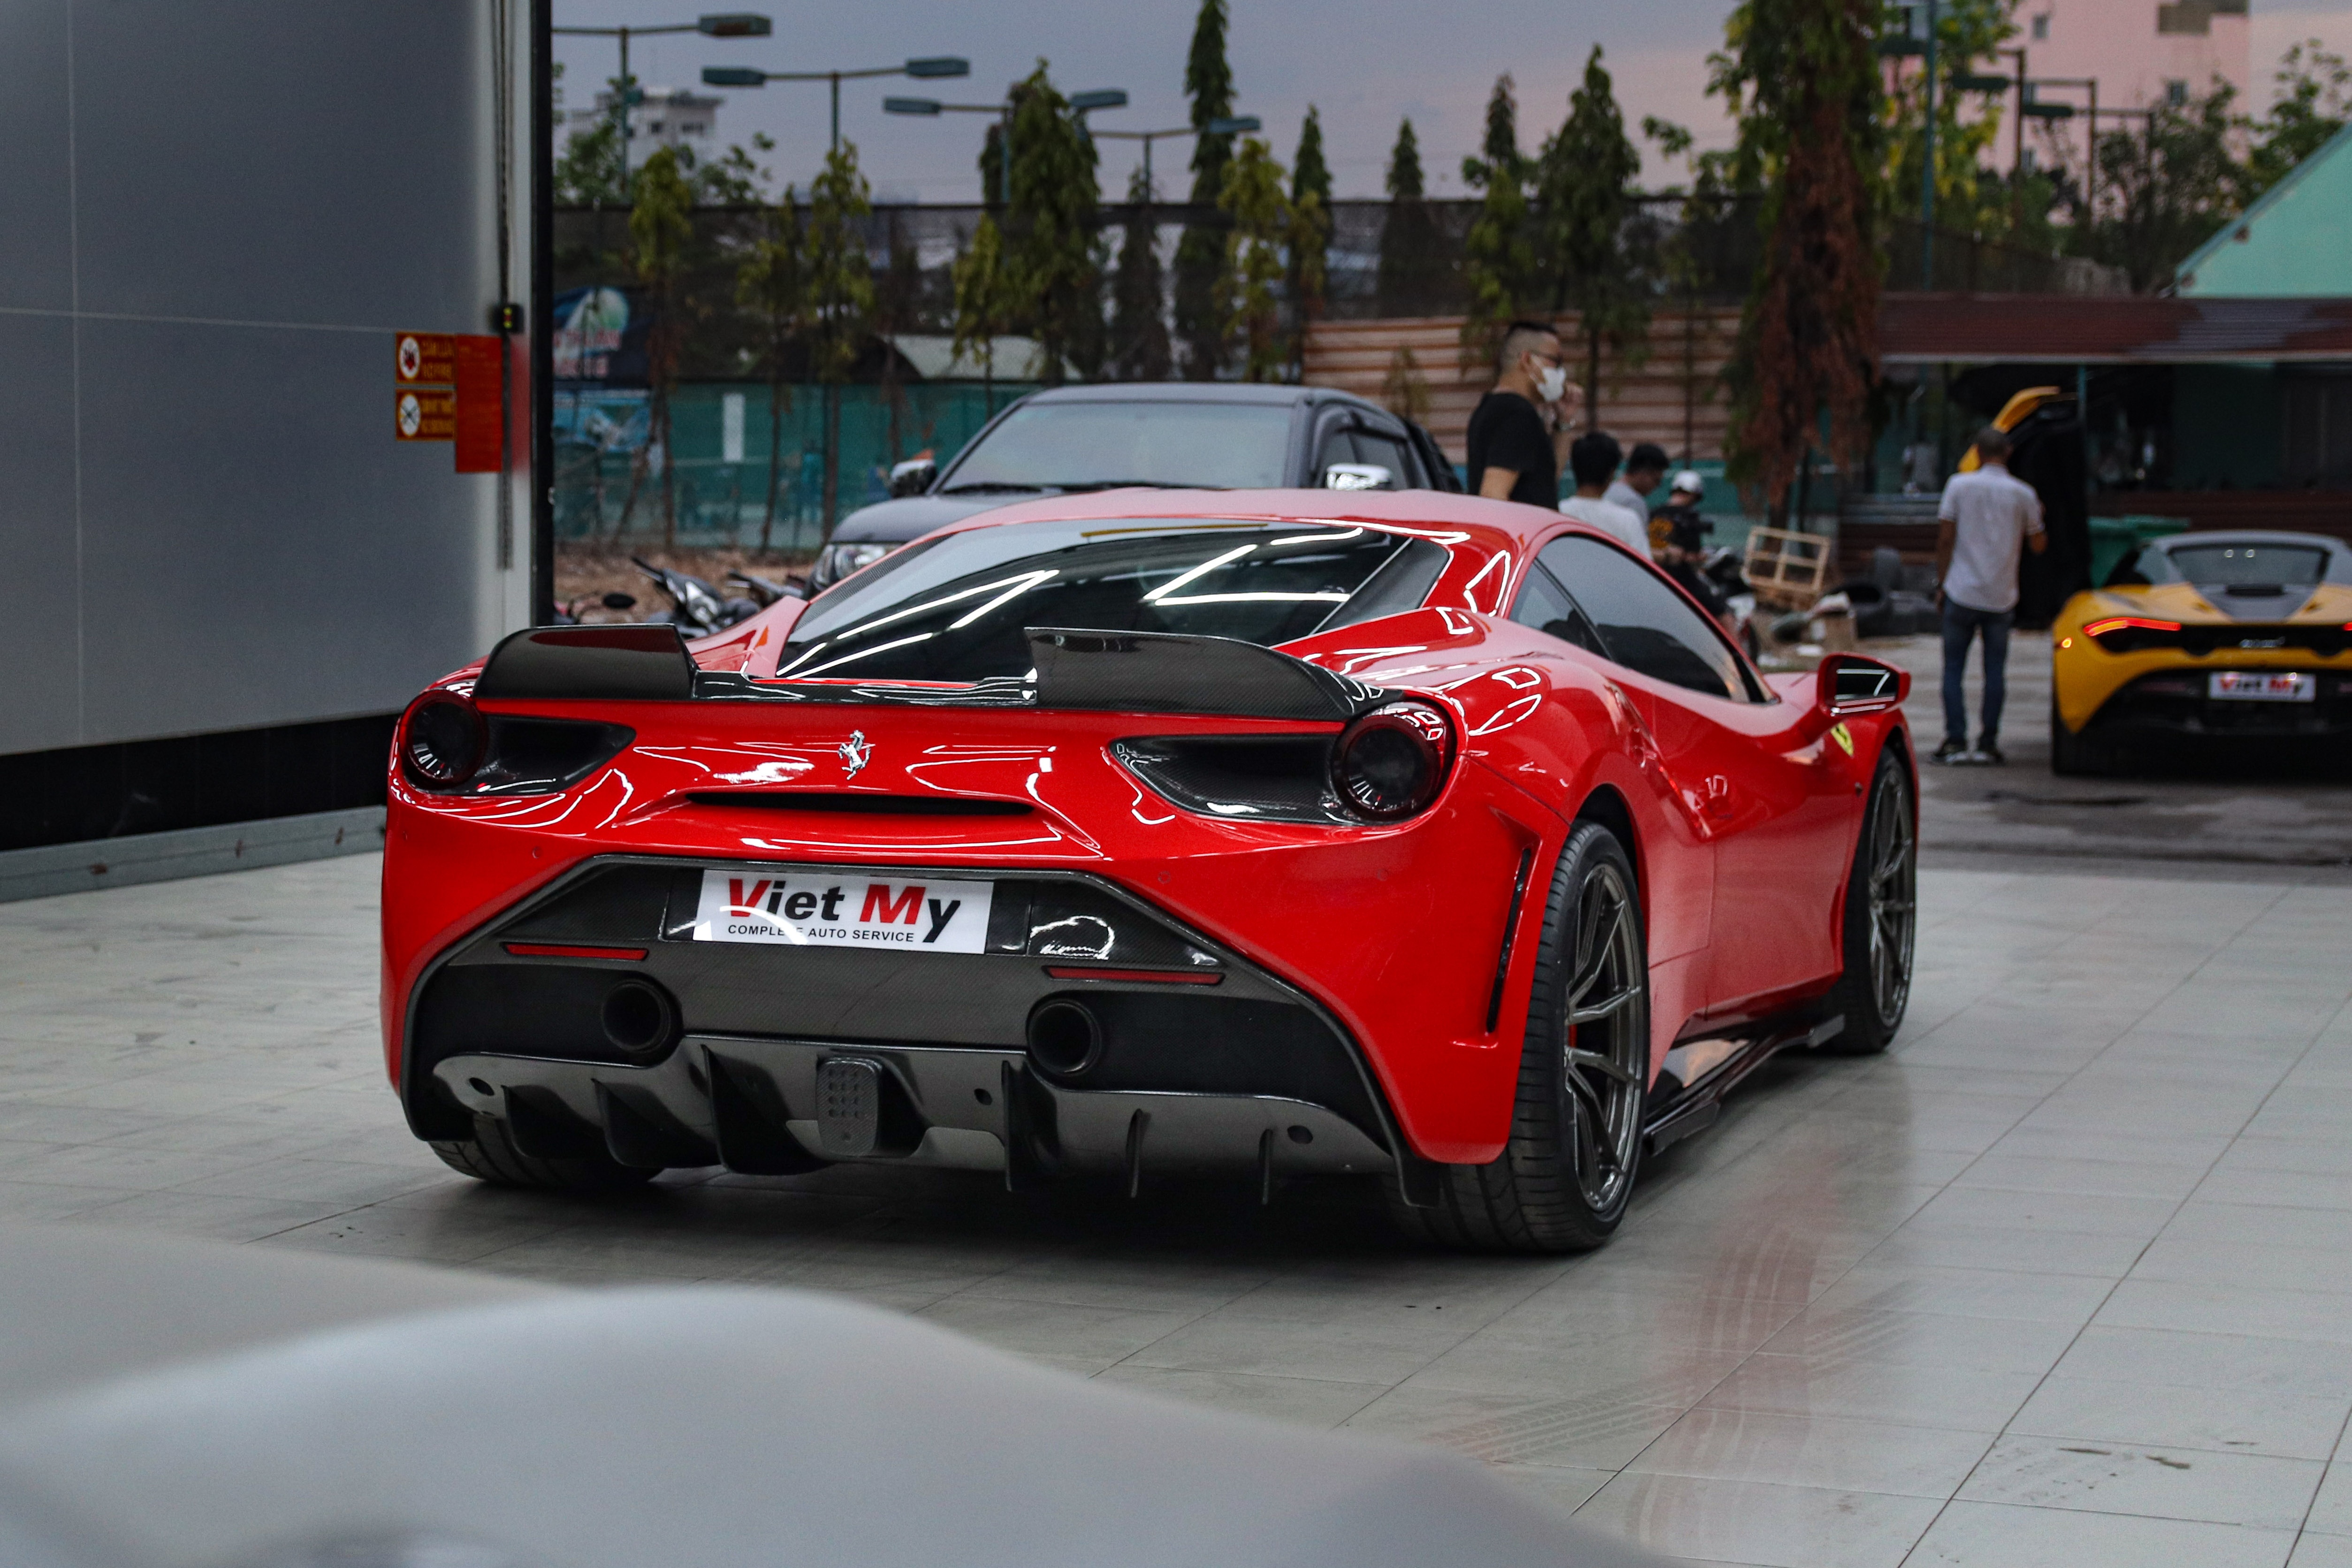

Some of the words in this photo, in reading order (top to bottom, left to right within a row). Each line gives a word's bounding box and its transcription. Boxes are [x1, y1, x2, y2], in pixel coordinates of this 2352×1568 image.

[729, 878, 845, 920] Viet
[860, 883, 961, 943] My
[728, 925, 803, 937] COMPLE
[808, 928, 846, 938] AUTO
[852, 929, 914, 942] SERVICE
